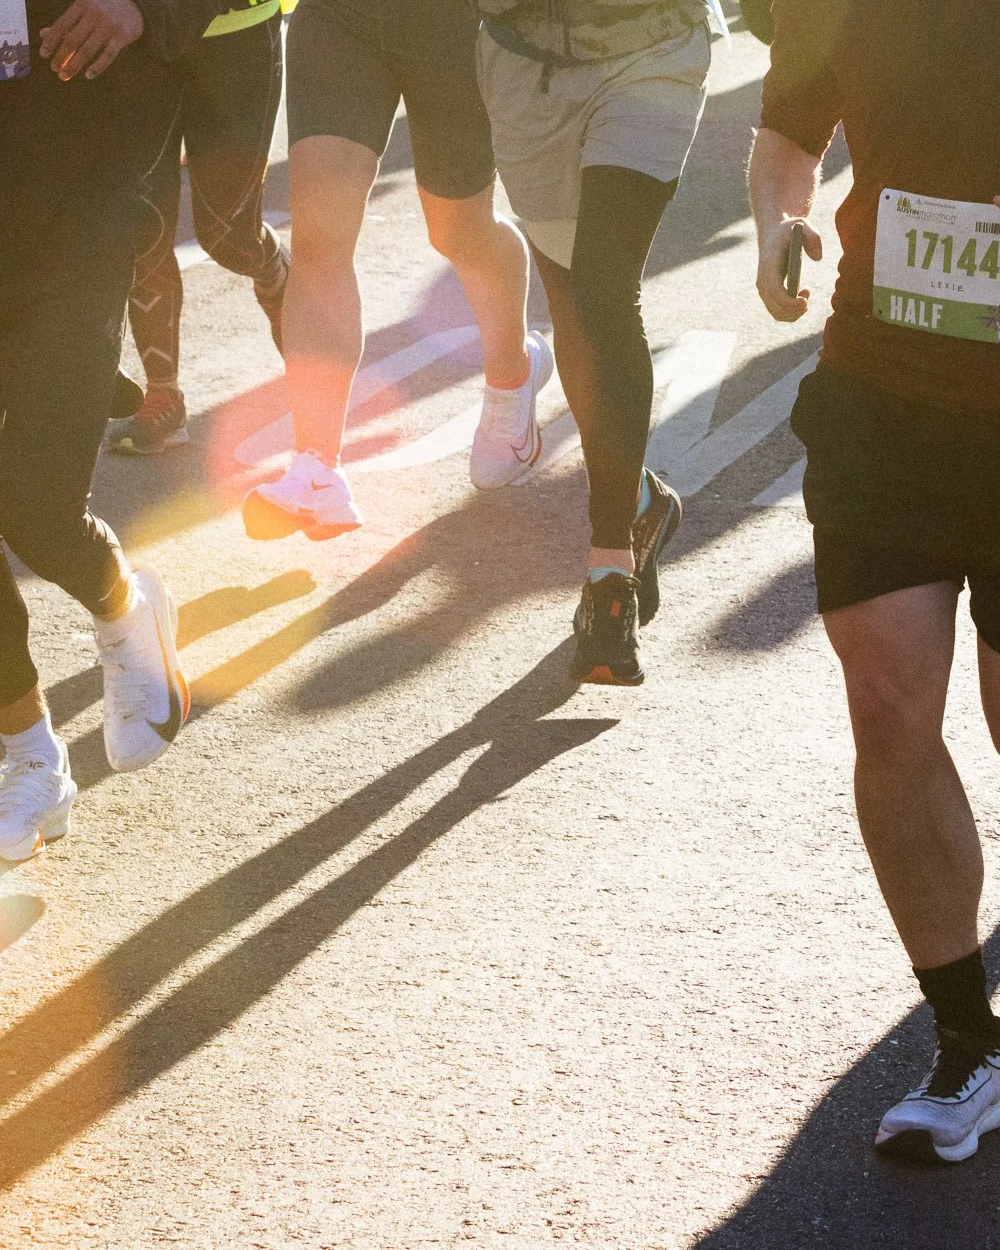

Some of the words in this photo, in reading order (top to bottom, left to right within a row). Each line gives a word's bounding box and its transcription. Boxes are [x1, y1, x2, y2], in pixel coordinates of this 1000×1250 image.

[904, 228, 1000, 279] 17144
[930, 281, 965, 292] LEXIE
[889, 295, 944, 329] HALF
